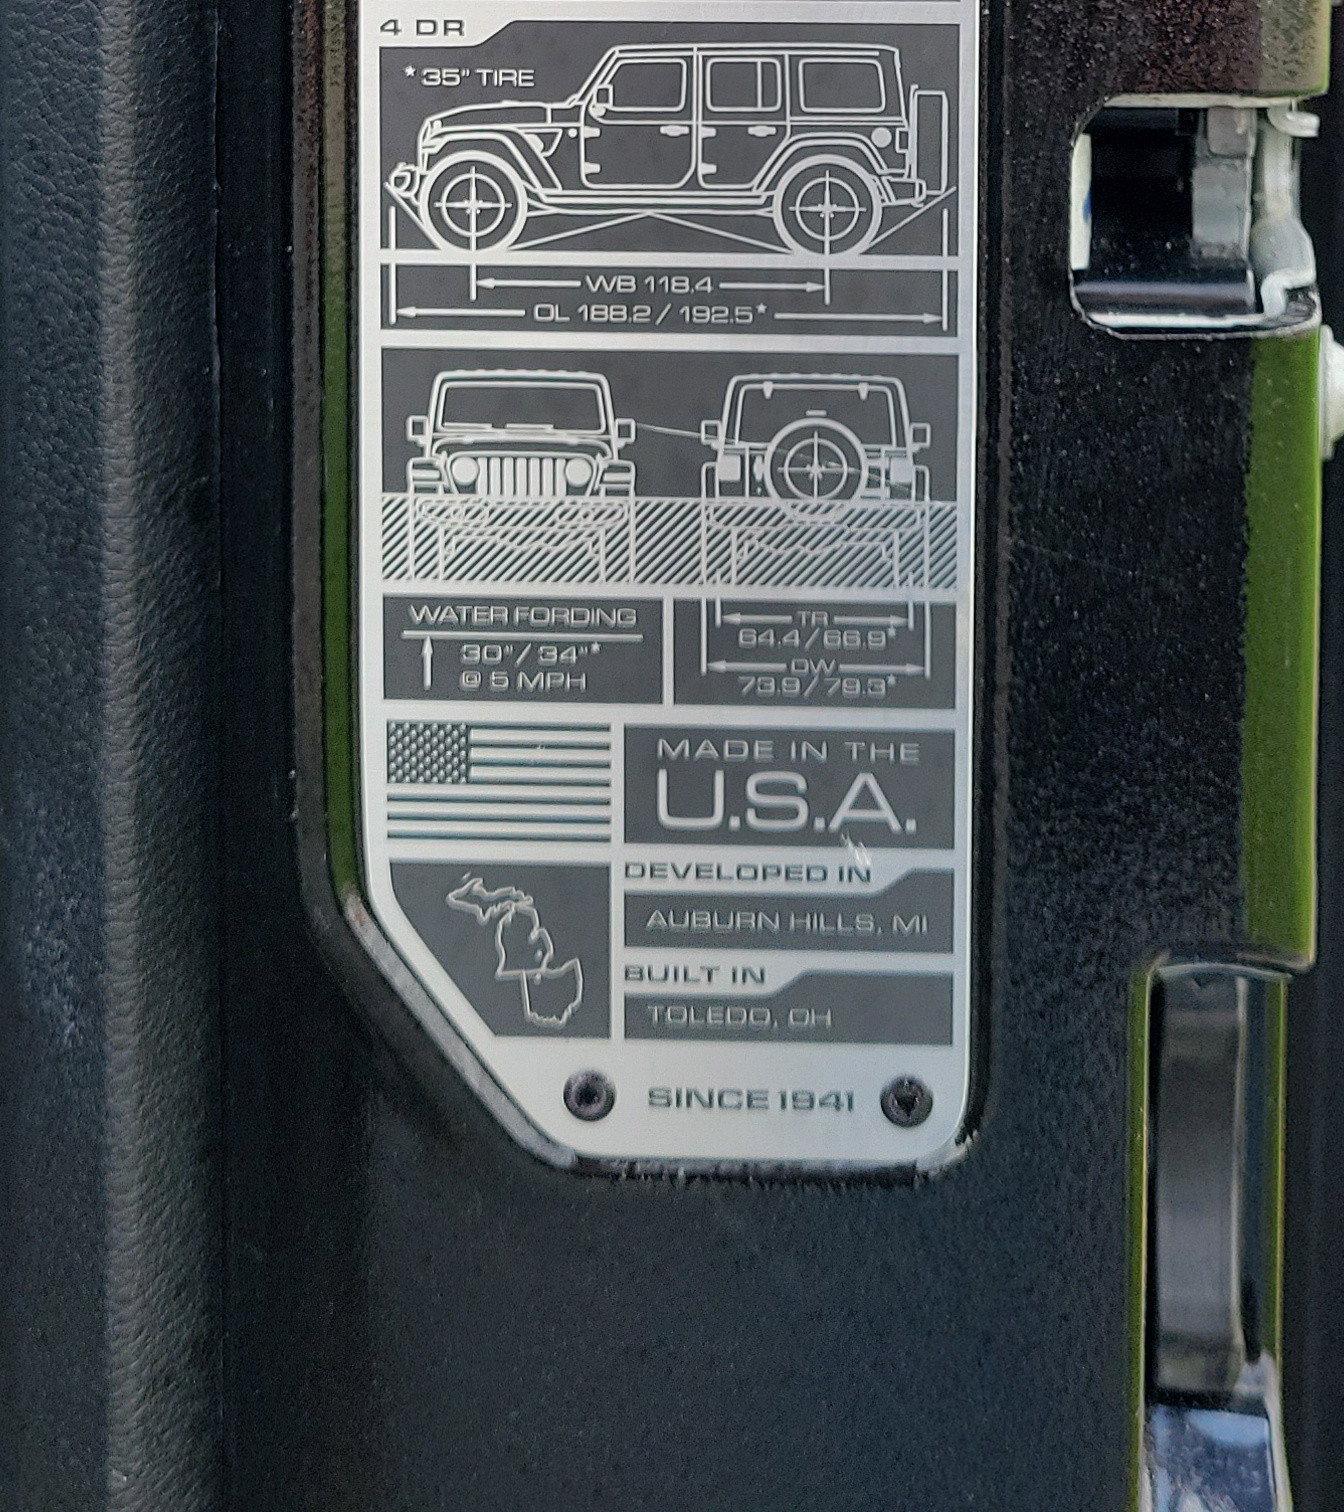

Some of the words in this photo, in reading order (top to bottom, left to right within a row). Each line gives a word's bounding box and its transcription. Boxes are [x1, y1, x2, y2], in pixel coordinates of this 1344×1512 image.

[380, 19, 402, 36] 4
[415, 19, 465, 36] DR
[475, 68, 536, 88] TIRE
[585, 274, 636, 294] WB
[644, 275, 713, 295] 118.4
[533, 303, 571, 323] OL
[409, 604, 508, 626] WATER
[513, 605, 637, 628] FORDING
[796, 610, 830, 628] TR
[459, 670, 482, 691] @
[489, 670, 509, 690] 5
[516, 671, 587, 692] MPH
[657, 738, 775, 762] MADE
[789, 739, 829, 763] IN
[844, 740, 920, 764] THE
[657, 768, 918, 835] U.S.A.
[624, 860, 829, 883] DEVELOPED
[838, 864, 873, 884] IN
[646, 909, 780, 933] AUBURN
[788, 911, 883, 935] HILLS,
[892, 913, 929, 935] MI
[624, 964, 720, 984] BUILT
[732, 966, 766, 985] IN
[647, 1004, 779, 1028] TOLEDO,
[787, 1006, 833, 1029] OH
[647, 1087, 770, 1110] SINCE
[778, 1089, 855, 1112] 1941
